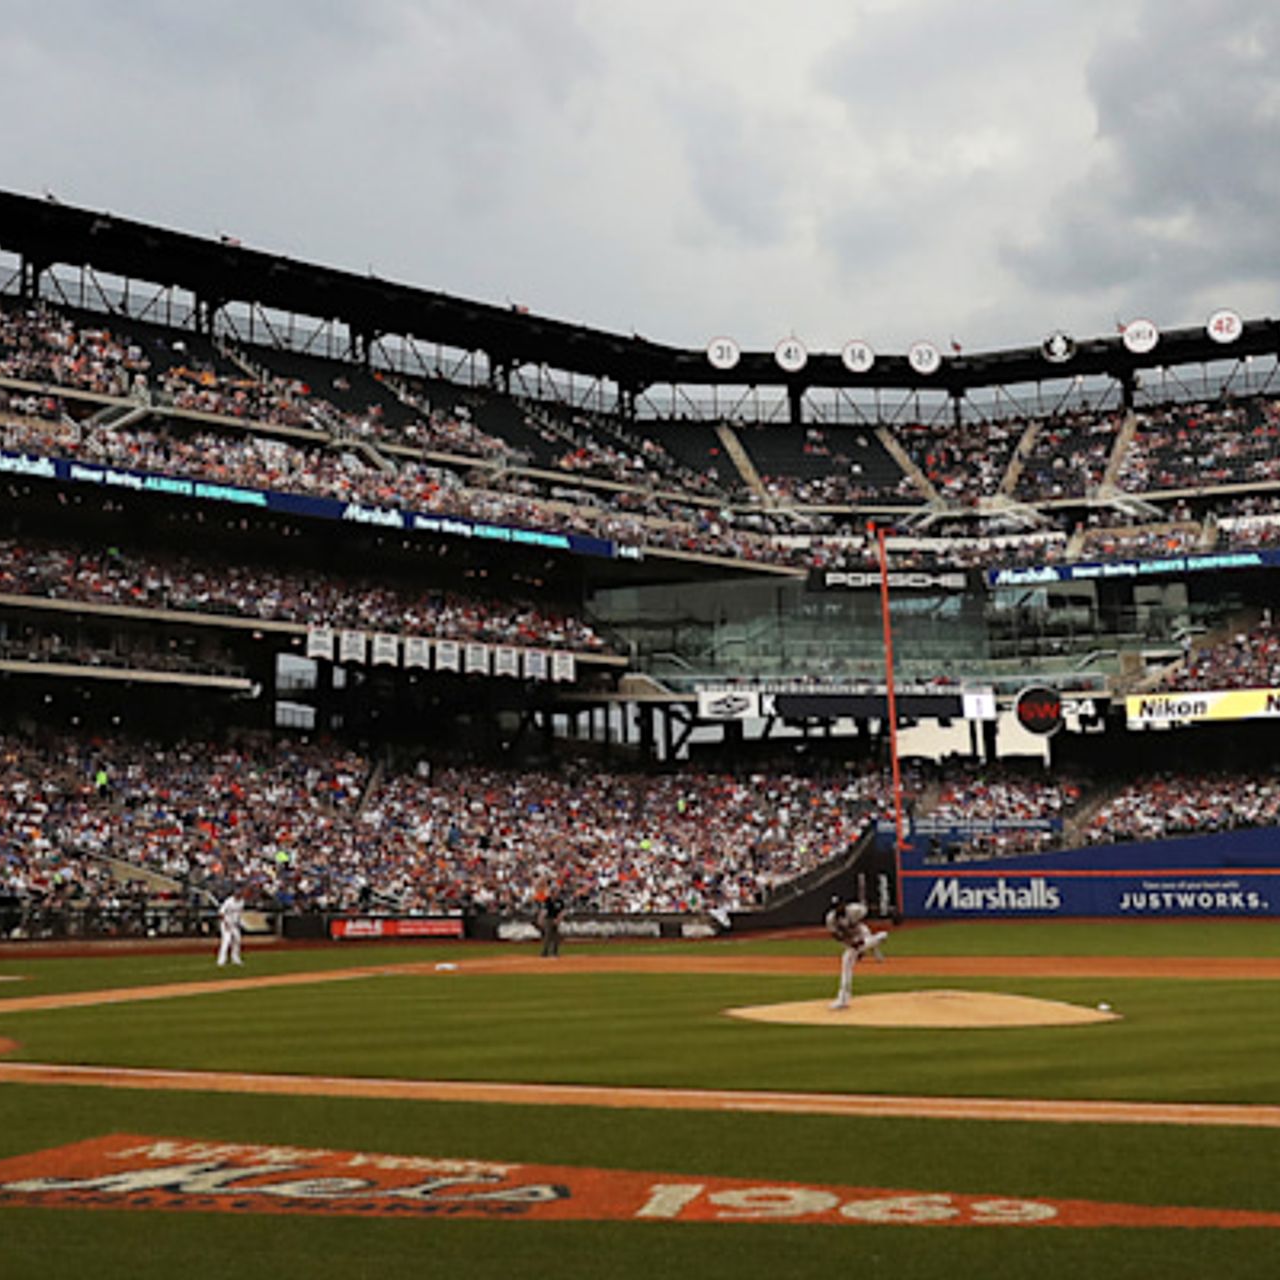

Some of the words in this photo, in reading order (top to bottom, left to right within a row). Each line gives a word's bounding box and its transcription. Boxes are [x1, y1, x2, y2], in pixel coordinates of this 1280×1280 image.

[1213, 316, 1235, 335] 42
[783, 346, 800, 361] 41
[825, 572, 966, 588] PORSCHE
[1139, 697, 1208, 719] Nikon
[925, 878, 1060, 909] Marshalls
[1120, 892, 1269, 910] JUSTWORKS.
[632, 1182, 1059, 1224] 1969
